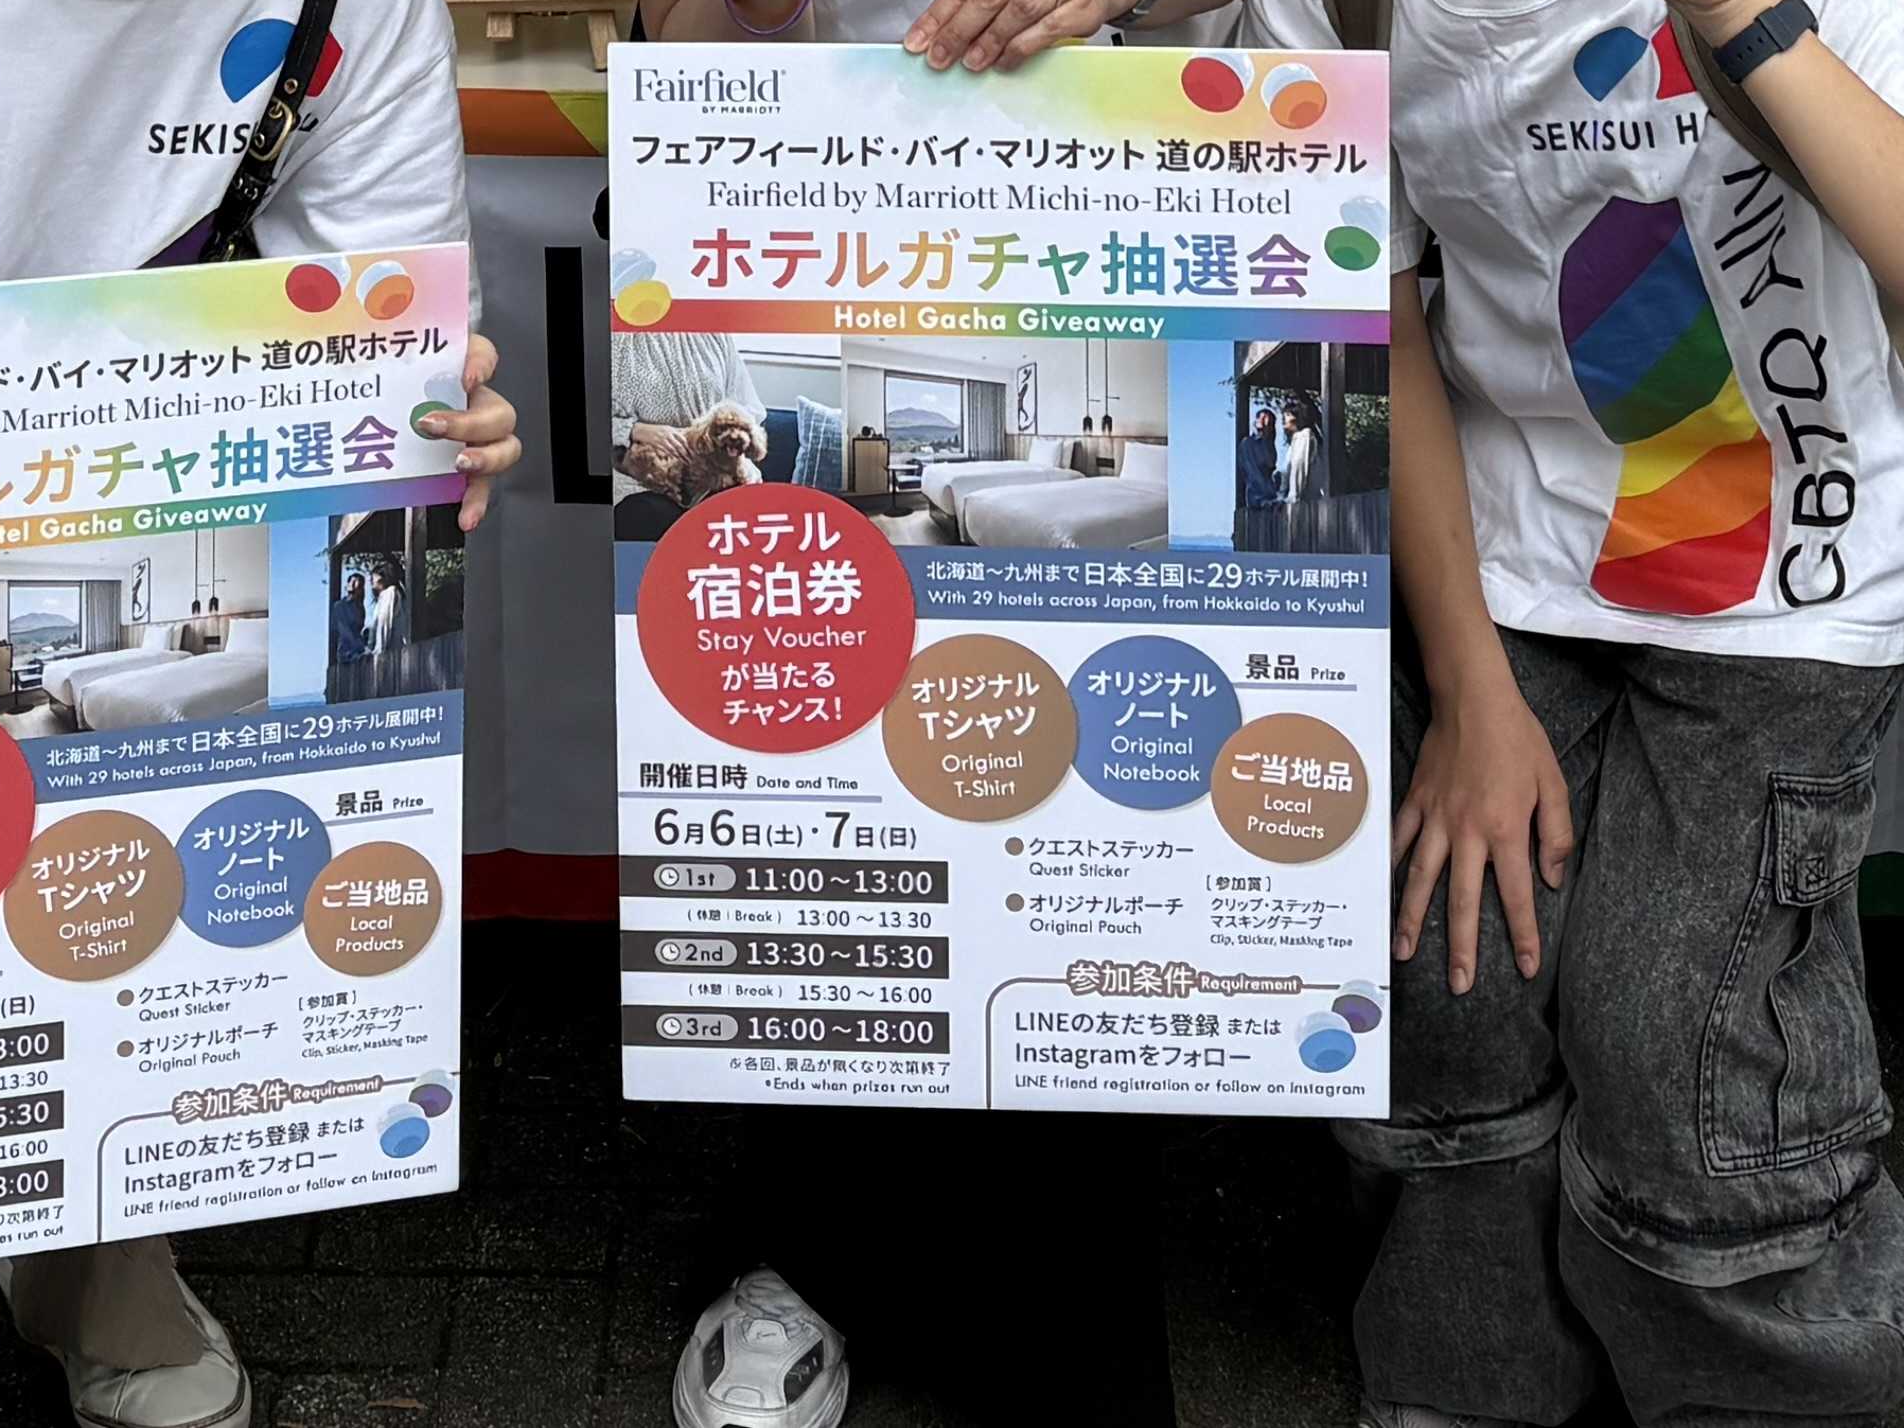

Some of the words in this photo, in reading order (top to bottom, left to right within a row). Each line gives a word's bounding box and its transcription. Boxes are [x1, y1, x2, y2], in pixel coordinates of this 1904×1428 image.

[633, 68, 781, 104] Fairfield
[1526, 120, 1655, 152] SEKISUI
[631, 135, 1145, 172] フェアフィールド・バイ・マリオット
[1156, 138, 1367, 174] 道の駅ホテル
[706, 180, 825, 208] Fairfield
[833, 181, 867, 215] by
[874, 183, 999, 210] Marriott
[1006, 184, 1201, 214] Michi-no-Eki
[1212, 187, 1292, 215] Hotel
[690, 228, 1311, 298] ホテルガチャ抽選会
[833, 305, 906, 329] Hotel
[918, 306, 1007, 331] Gacha
[1017, 308, 1165, 339] Giveaway
[2, 402, 115, 431] Marriott
[131, 503, 266, 538] Giveaway
[707, 511, 842, 556] ホテル
[686, 559, 862, 621] 宿泊券
[972, 590, 993, 606] 29
[998, 590, 1044, 607] hotels
[1049, 593, 1098, 608] across
[1162, 595, 1198, 611] from
[1203, 596, 1280, 613] Hokkaido
[1285, 598, 1302, 613] to
[697, 628, 755, 656] Stay
[763, 624, 867, 649] Voucher
[720, 660, 836, 692] が当たる
[1244, 654, 1299, 681] 景品
[1310, 667, 1346, 682] Prize
[910, 670, 1040, 705] オリジナル
[1086, 669, 1218, 700] オリジナル
[722, 696, 843, 726] チャンス!
[918, 704, 1037, 742] Tシャツ
[1113, 702, 1189, 730] ノート
[1110, 736, 1193, 757] Original
[639, 762, 749, 789] 開催日時
[941, 751, 1023, 775] Original
[1103, 763, 1200, 784] Notebook
[1231, 752, 1354, 793] ご当地品
[953, 780, 1016, 799] T-Shirt
[1263, 794, 1312, 815] Local
[1246, 815, 1325, 841] Products
[218, 847, 284, 875] ノート
[1028, 838, 1195, 859] クエストステッカー
[37, 868, 145, 912] Tシャツ
[322, 879, 429, 918] ご当地品
[1029, 895, 1183, 915] オリジナルポーチ
[684, 942, 724, 962] 2nd
[1069, 964, 1195, 995] 参加条件
[686, 1018, 723, 1037] 3rd
[1014, 1010, 1220, 1038] LINEの友だち登録
[1226, 1017, 1282, 1036] または
[1014, 1042, 1252, 1070] Instagramをフォロー
